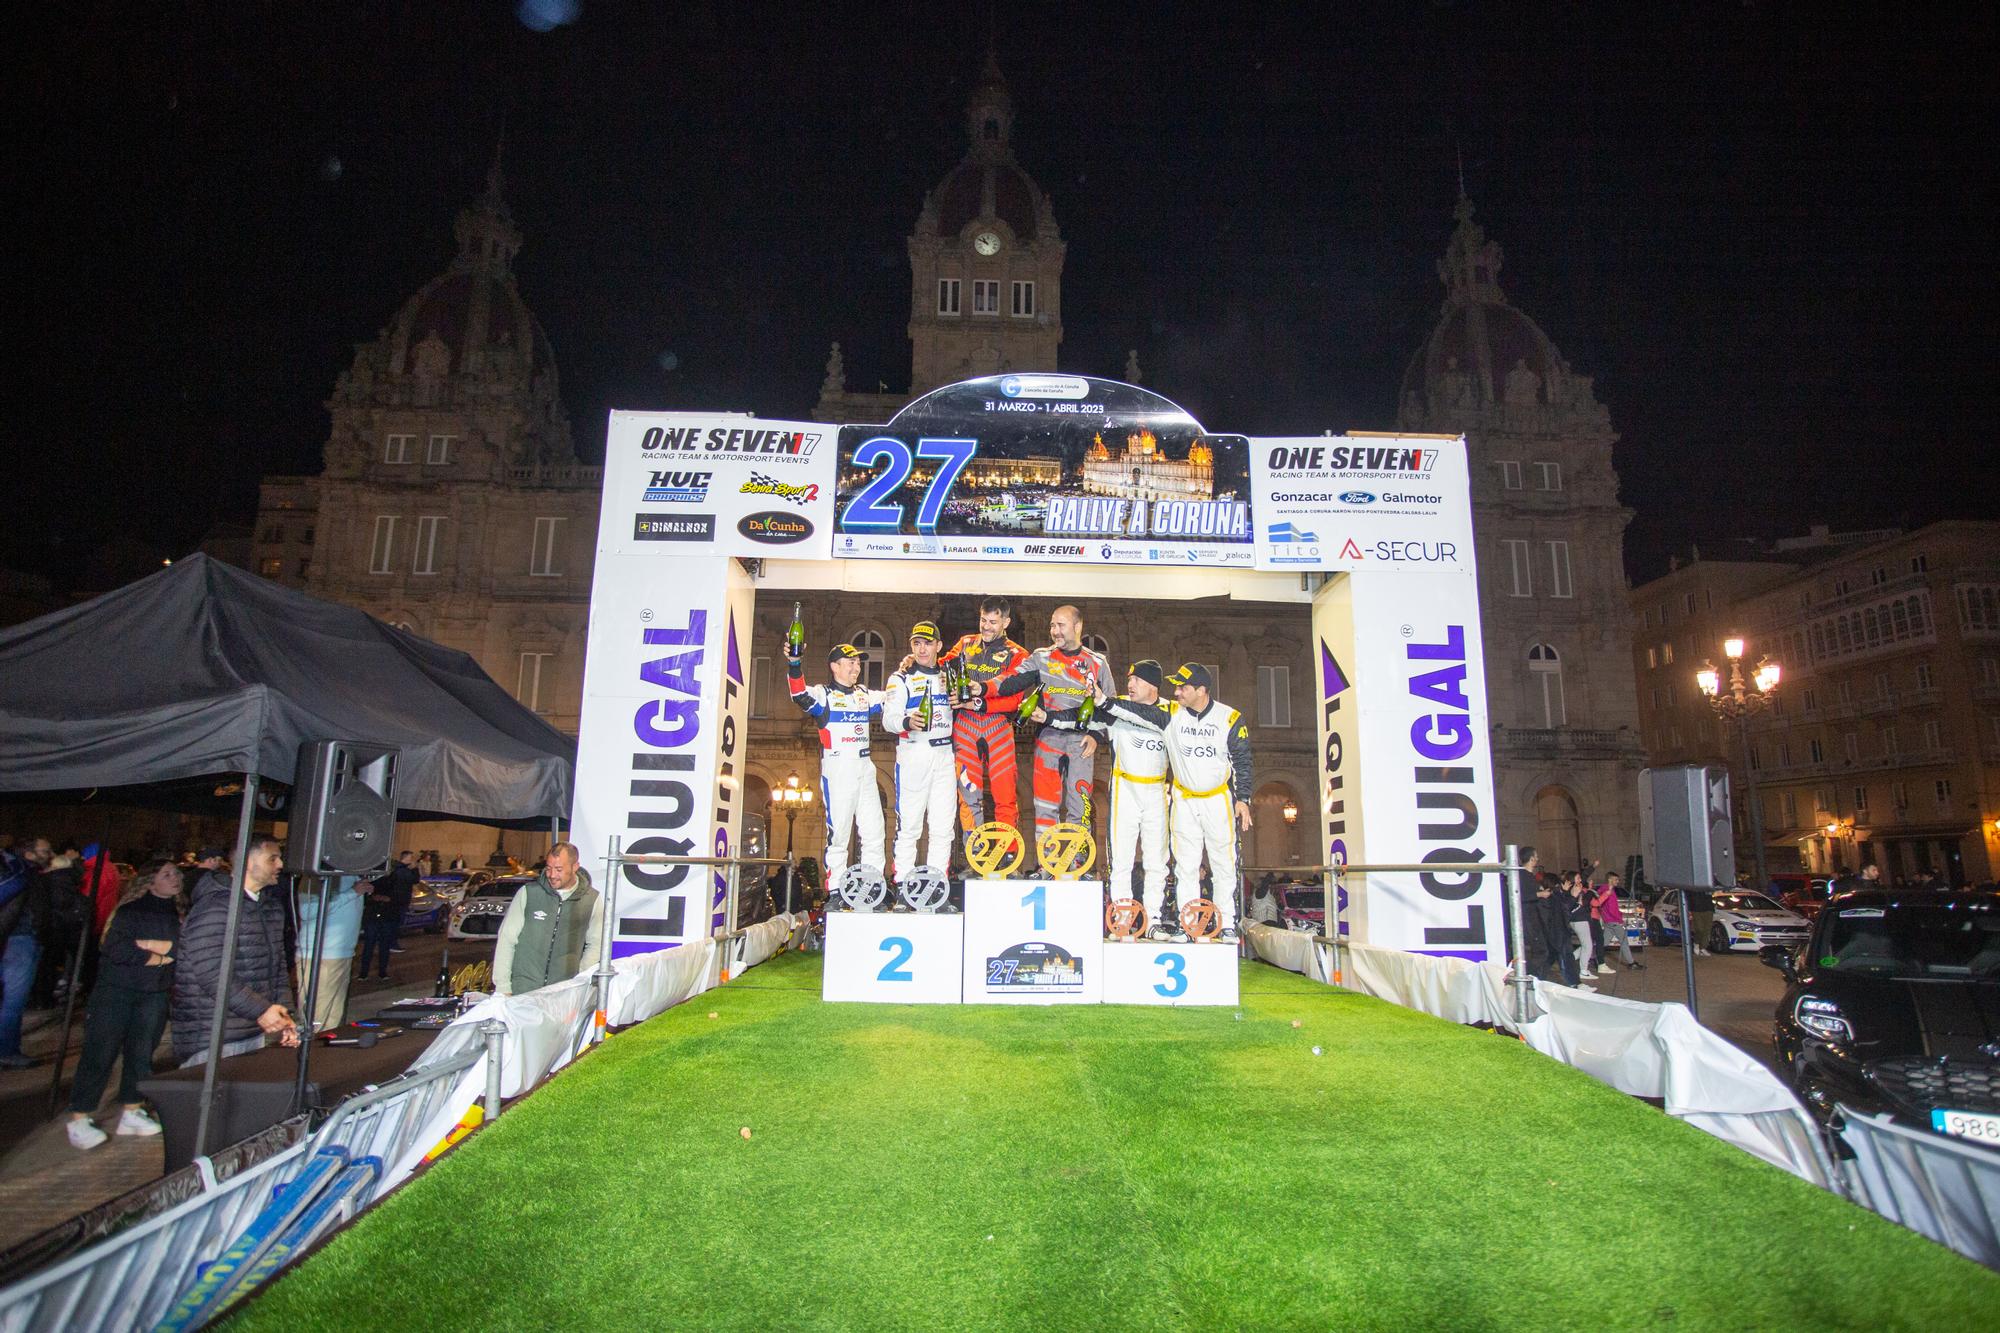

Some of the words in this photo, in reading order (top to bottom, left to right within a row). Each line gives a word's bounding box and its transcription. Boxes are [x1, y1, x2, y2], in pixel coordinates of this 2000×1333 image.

[985, 402, 995, 411] 31
[998, 402, 1036, 412] MARZO
[1045, 403, 1050, 412] 1
[1053, 403, 1079, 413] ABRIL
[1080, 404, 1104, 414] 2023
[641, 427, 702, 450] ONE
[677, 453, 701, 461] TEAM
[711, 454, 772, 463] MOTORSPORT
[774, 456, 810, 465] EVENTS
[1268, 447, 1325, 469] ONE
[647, 471, 713, 488] HVC
[841, 437, 977, 526] 27
[774, 483, 808, 498] Sport
[805, 483, 819, 501] 2
[1271, 492, 1333, 502] Gonzacar
[1345, 493, 1371, 503] Ford
[1382, 493, 1442, 504] Galmotor
[1046, 498, 1126, 532] RALLYE
[1130, 500, 1145, 533] A
[1153, 497, 1246, 535] CORUÑA
[651, 521, 708, 533] DIMALNOX
[749, 520, 764, 530] Da
[769, 521, 806, 532] Cunha
[947, 545, 978, 553] ARANGA
[1024, 544, 1048, 554] ONE
[1270, 544, 1319, 556] Tito
[1021, 886, 1046, 930] 1
[877, 937, 913, 981] 2
[987, 960, 1019, 984] 27
[1153, 952, 1188, 998] 3
